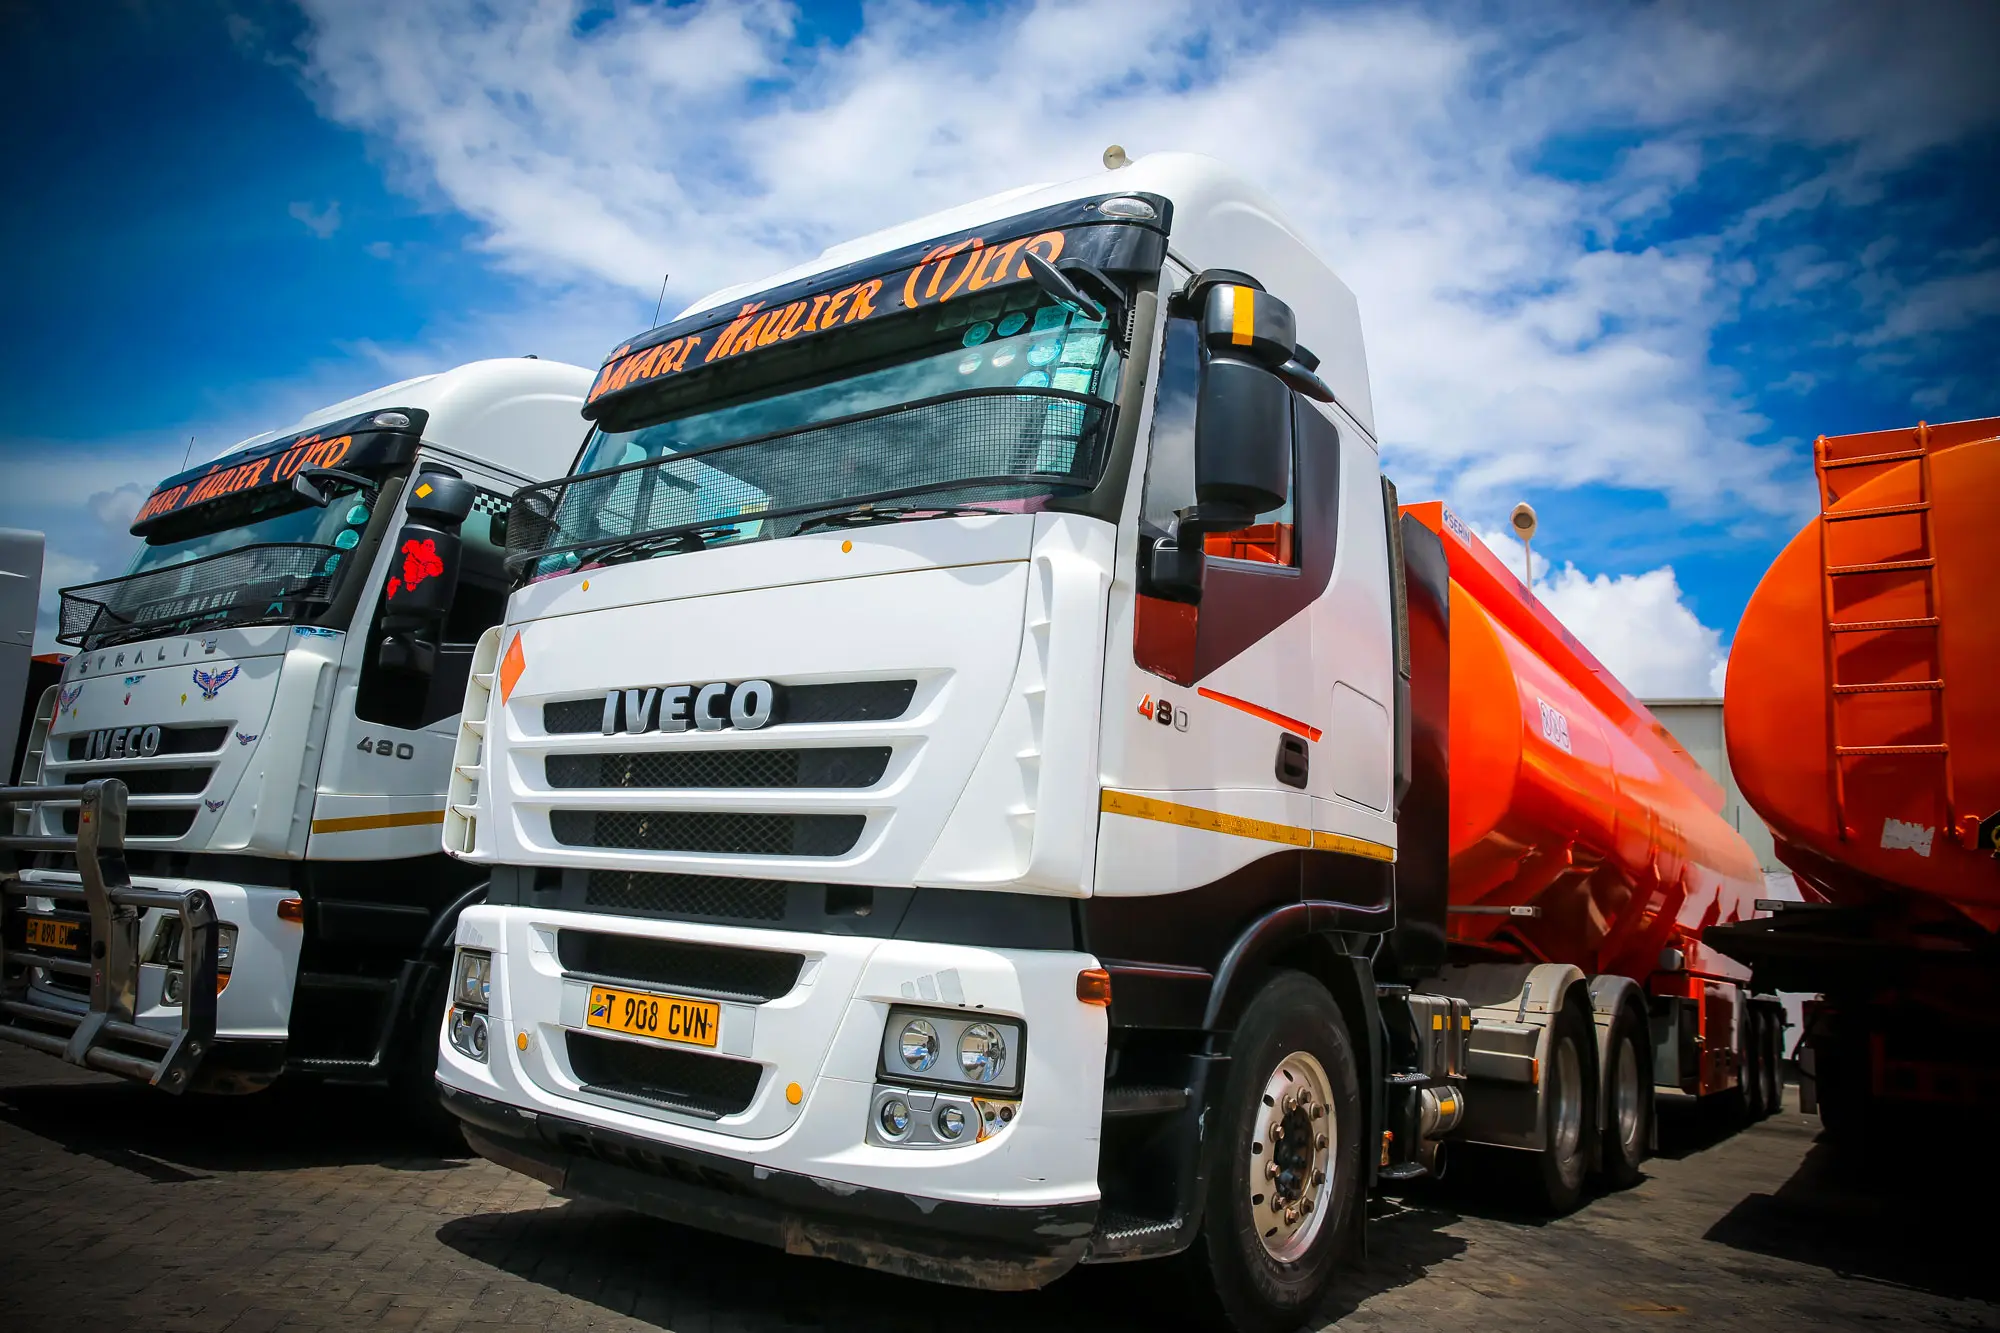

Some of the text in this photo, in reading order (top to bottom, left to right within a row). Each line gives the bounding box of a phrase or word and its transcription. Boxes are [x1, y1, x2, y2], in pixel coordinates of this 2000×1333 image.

[587, 338, 700, 402] SAFARI
[704, 279, 883, 363] HAULIER
[602, 679, 773, 736] IVECO
[1137, 692, 1190, 733] 480
[84, 725, 161, 761] IVECO
[356, 735, 415, 760] 480
[605, 994, 709, 1040] T 908 CVN
